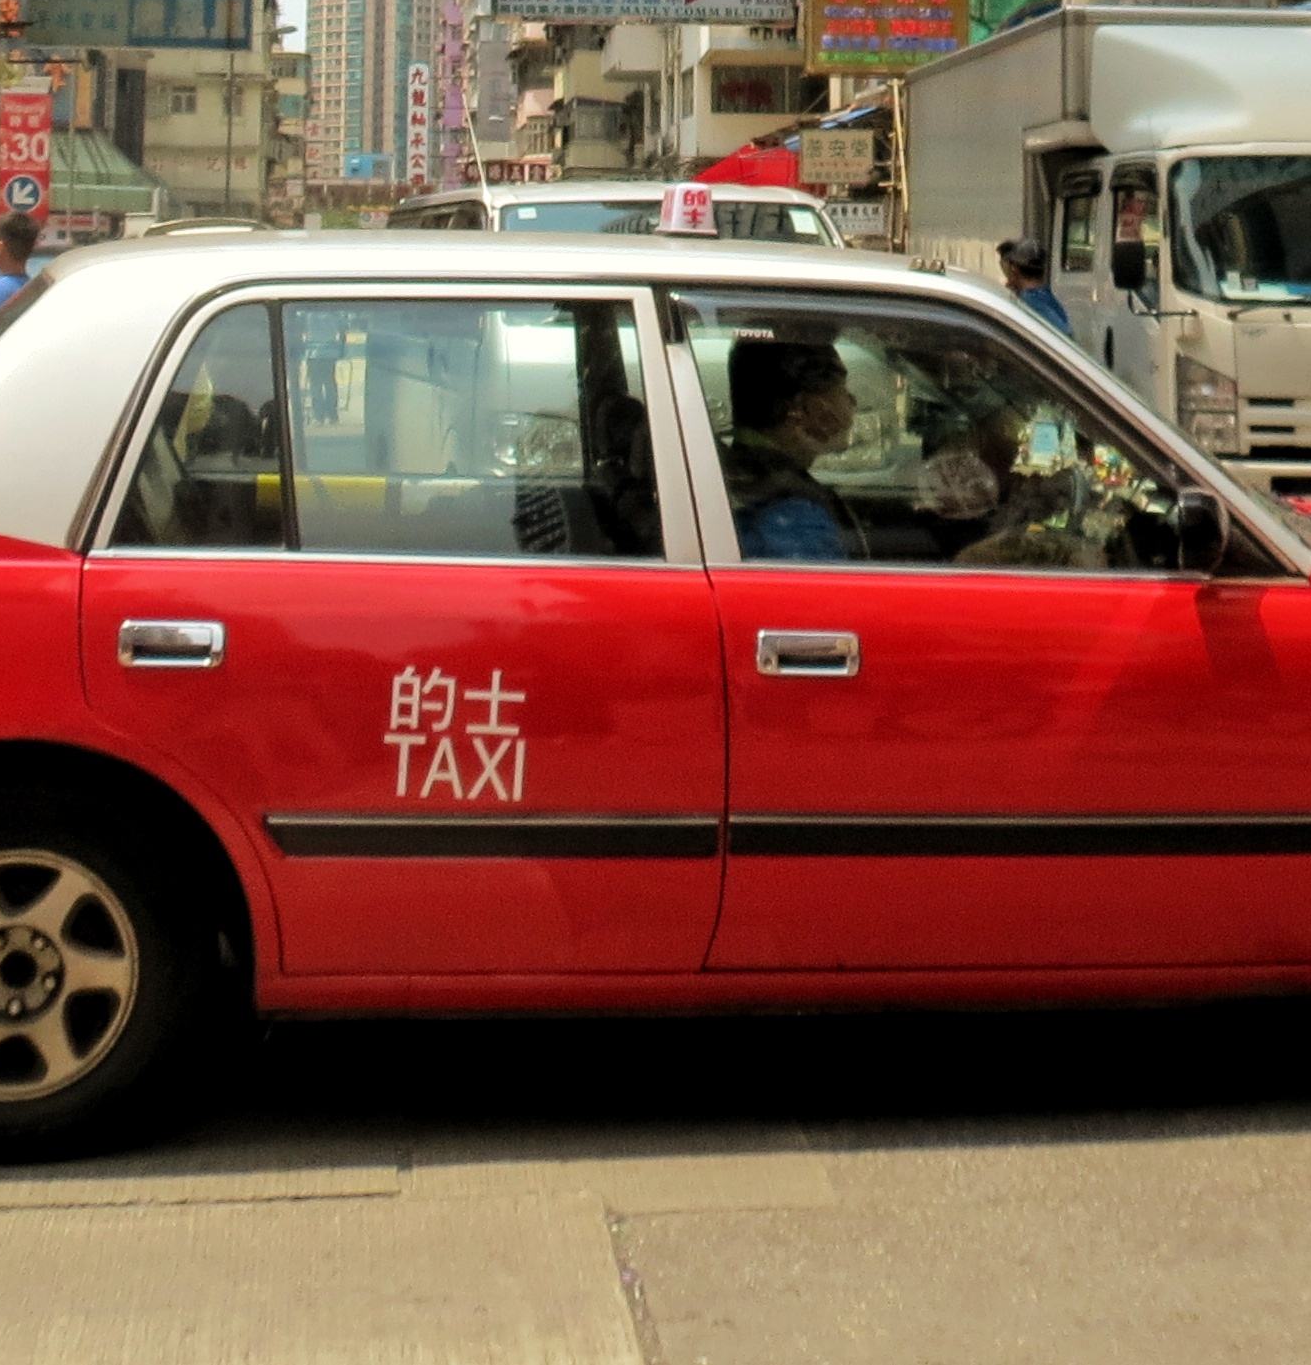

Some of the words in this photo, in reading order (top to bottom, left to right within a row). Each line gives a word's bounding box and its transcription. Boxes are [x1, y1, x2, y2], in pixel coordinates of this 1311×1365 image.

[683, 190, 707, 229] 的士
[390, 664, 527, 734] 的士
[383, 733, 527, 803] TAXI
